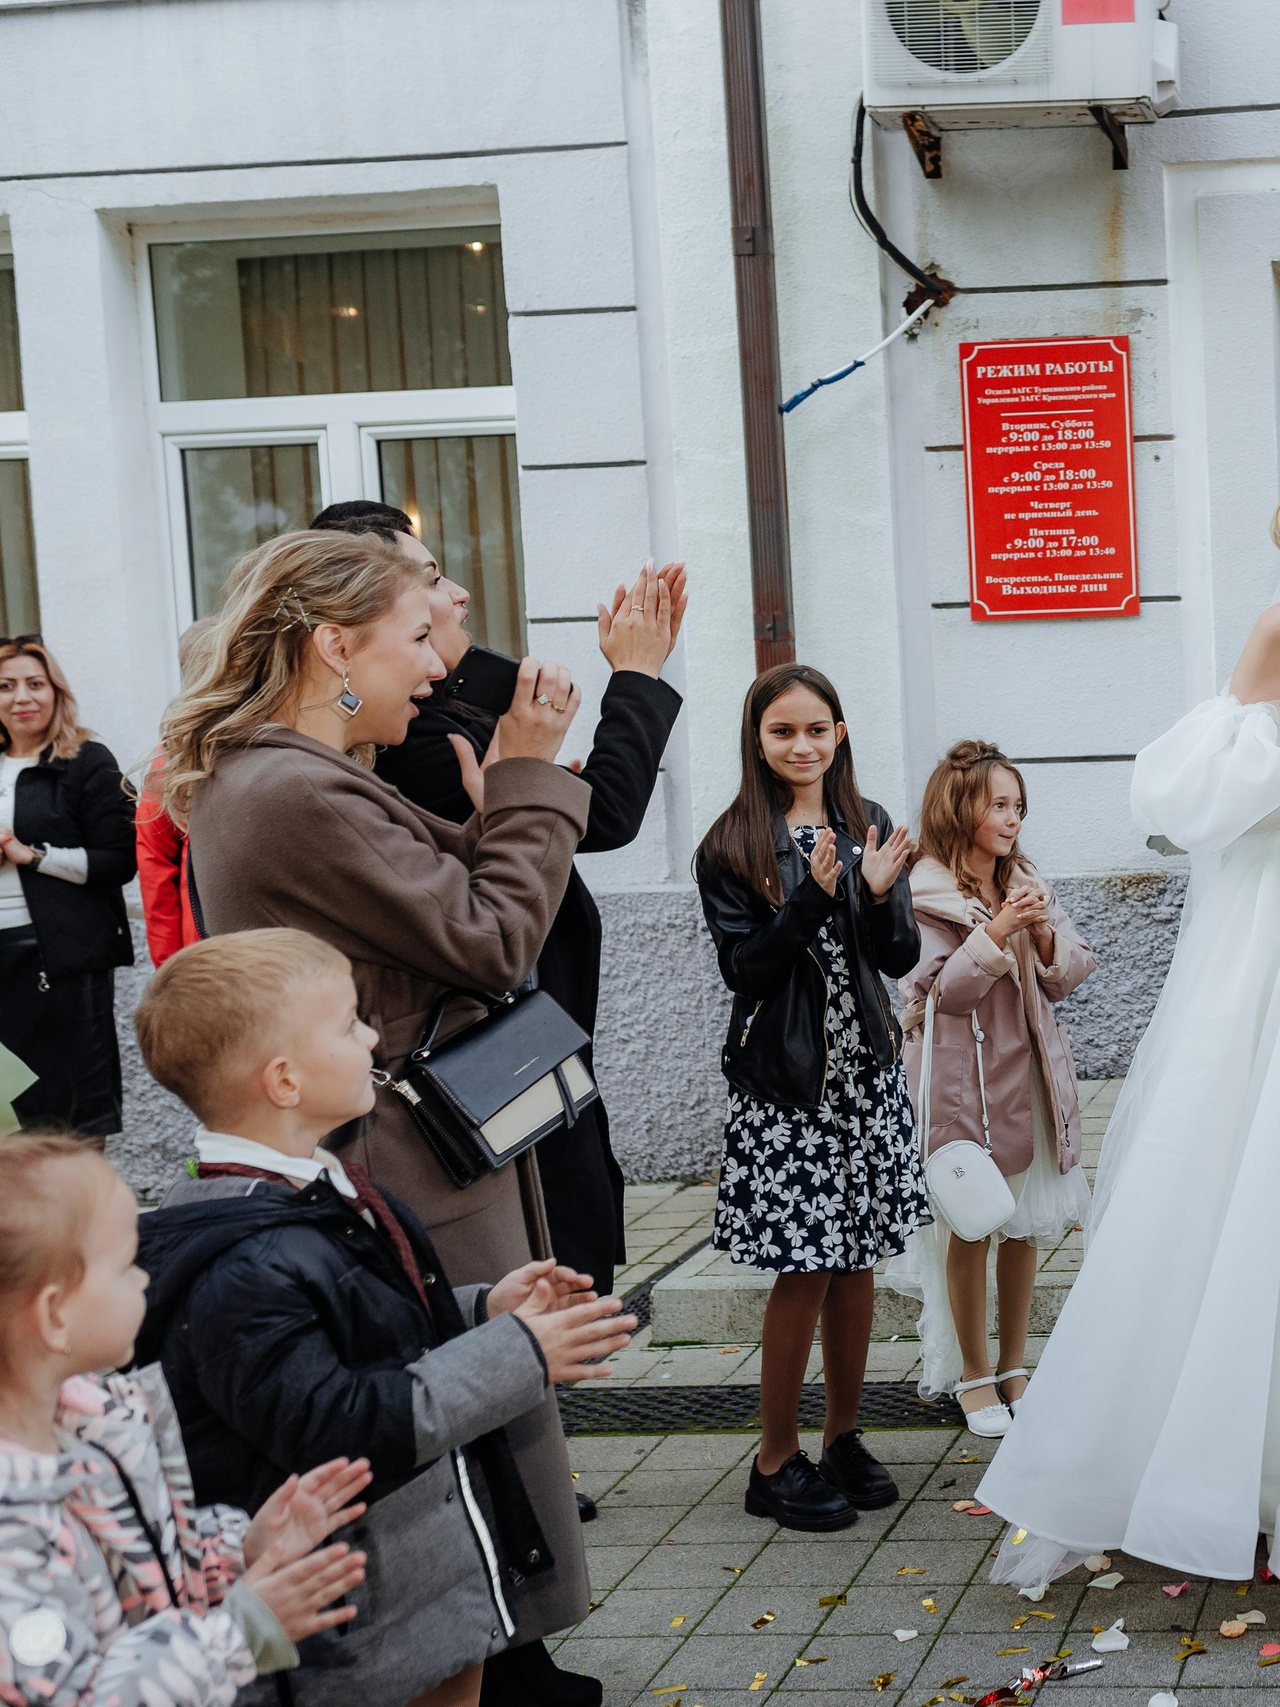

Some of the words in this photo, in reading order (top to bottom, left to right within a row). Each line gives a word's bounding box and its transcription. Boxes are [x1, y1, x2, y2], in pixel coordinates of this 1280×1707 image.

[976, 364, 1040, 378] РЕЖИМ
[1045, 361, 1114, 375] РАБОТЫ
[1001, 422, 1050, 431] Вторник,
[1051, 420, 1094, 429] Суббота
[1009, 431, 1039, 442] 9:00
[1041, 434, 1054, 442] до
[1057, 429, 1095, 440] 18:00
[986, 446, 1030, 454] перерыв
[1041, 443, 1068, 451] 13:00
[1085, 441, 1111, 449] 13:50
[1033, 461, 1065, 470] Среда
[1011, 471, 1041, 482] 9:00
[1043, 474, 1056, 482] до
[1059, 469, 1096, 480] 18:00
[988, 485, 1032, 494] перерыв
[1043, 482, 1069, 491] 13:00
[1086, 481, 1113, 489] 13:50
[1030, 501, 1072, 509] Четверг
[1018, 510, 1073, 520] приемный
[1074, 509, 1099, 517] день
[1029, 528, 1075, 536] Пятница
[1014, 538, 1044, 549] 9:00
[1062, 536, 1099, 547] 17:00
[991, 552, 1035, 561] перерыв
[1046, 549, 1072, 557] 13:00
[1089, 547, 1115, 555] 13:40
[985, 575, 1052, 584] Воскресенье,
[1055, 572, 1123, 581] Понедельник
[1002, 584, 1077, 596] Выходные
[1080, 584, 1108, 593] дни
